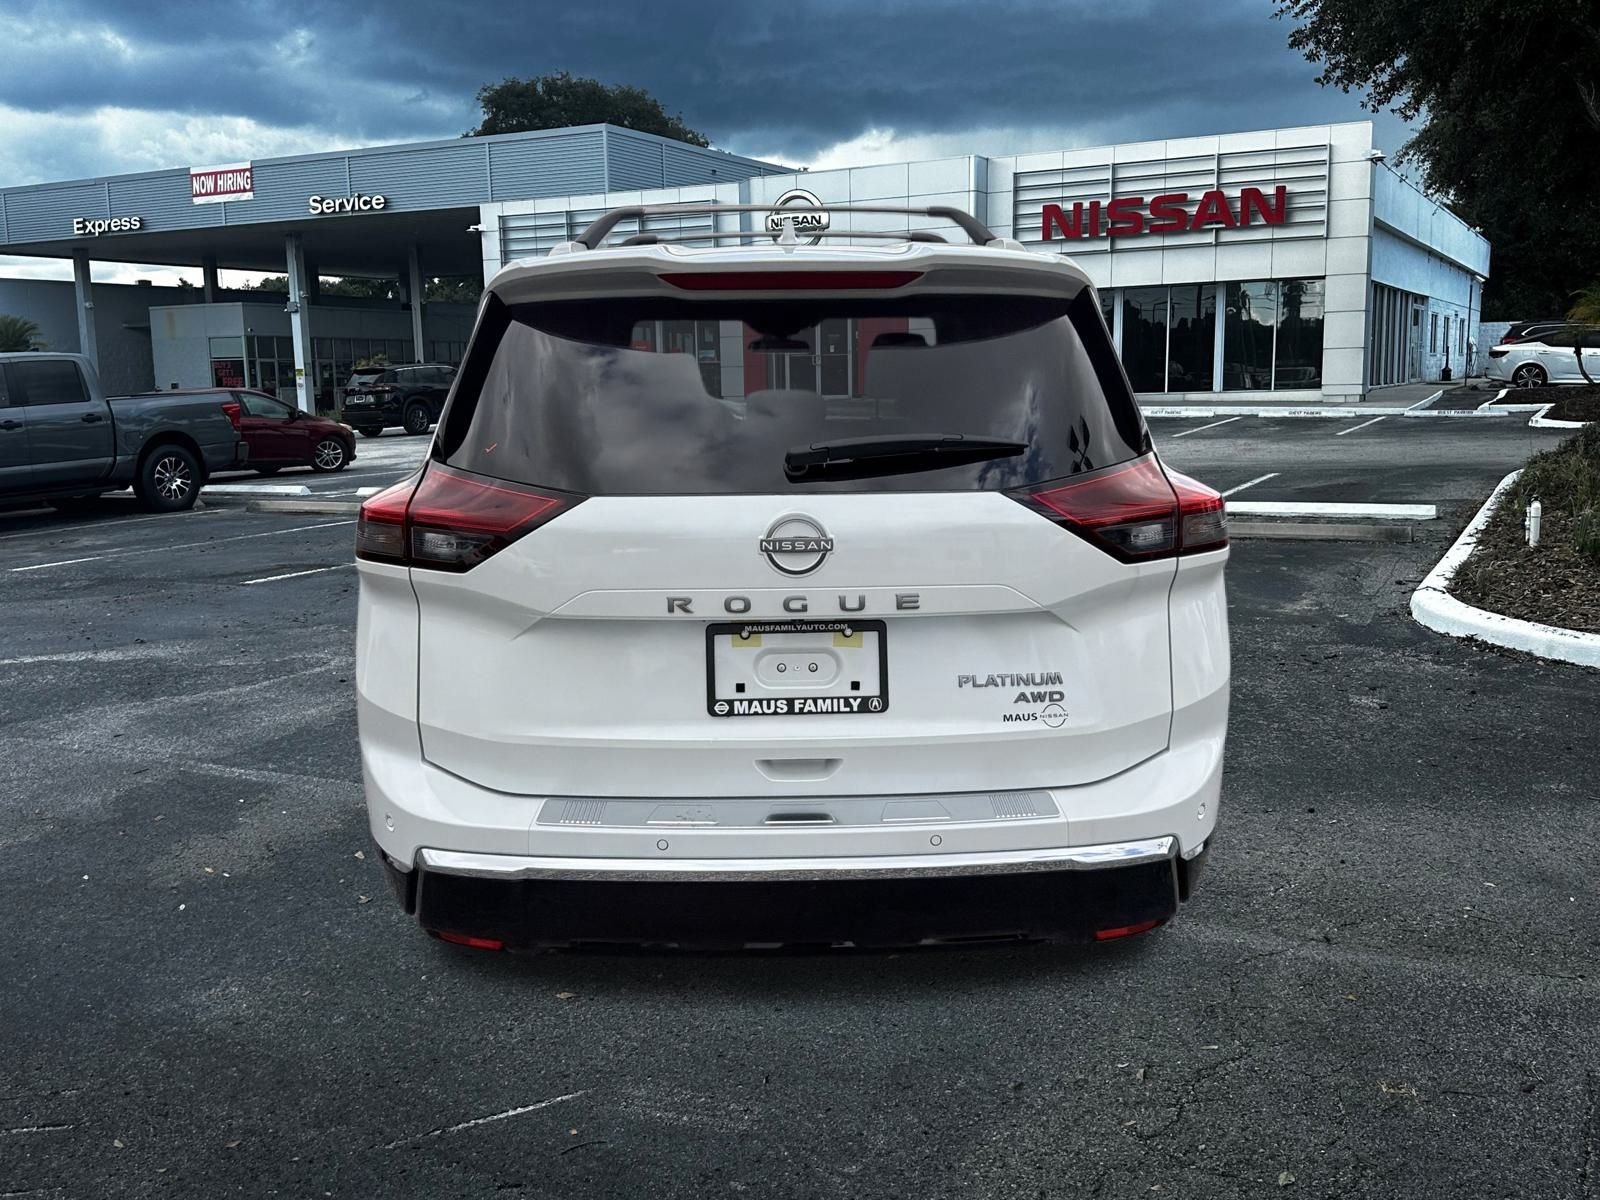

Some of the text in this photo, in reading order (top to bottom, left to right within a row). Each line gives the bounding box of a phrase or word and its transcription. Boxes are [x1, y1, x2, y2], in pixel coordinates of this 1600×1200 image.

[192, 171, 251, 195] NOW HIRING
[309, 194, 385, 214] Service
[1042, 185, 1287, 242] NISSAN
[73, 216, 141, 237] Express
[762, 541, 832, 551] NISSAN
[666, 593, 921, 614] ROGUE
[744, 623, 848, 633] MAUSFAMILYAUTO.COM
[958, 671, 1064, 688] PLATINUM
[1013, 690, 1065, 704] AWD
[733, 698, 862, 715] MAUS FAMILY
[1003, 712, 1038, 723] MAUS
